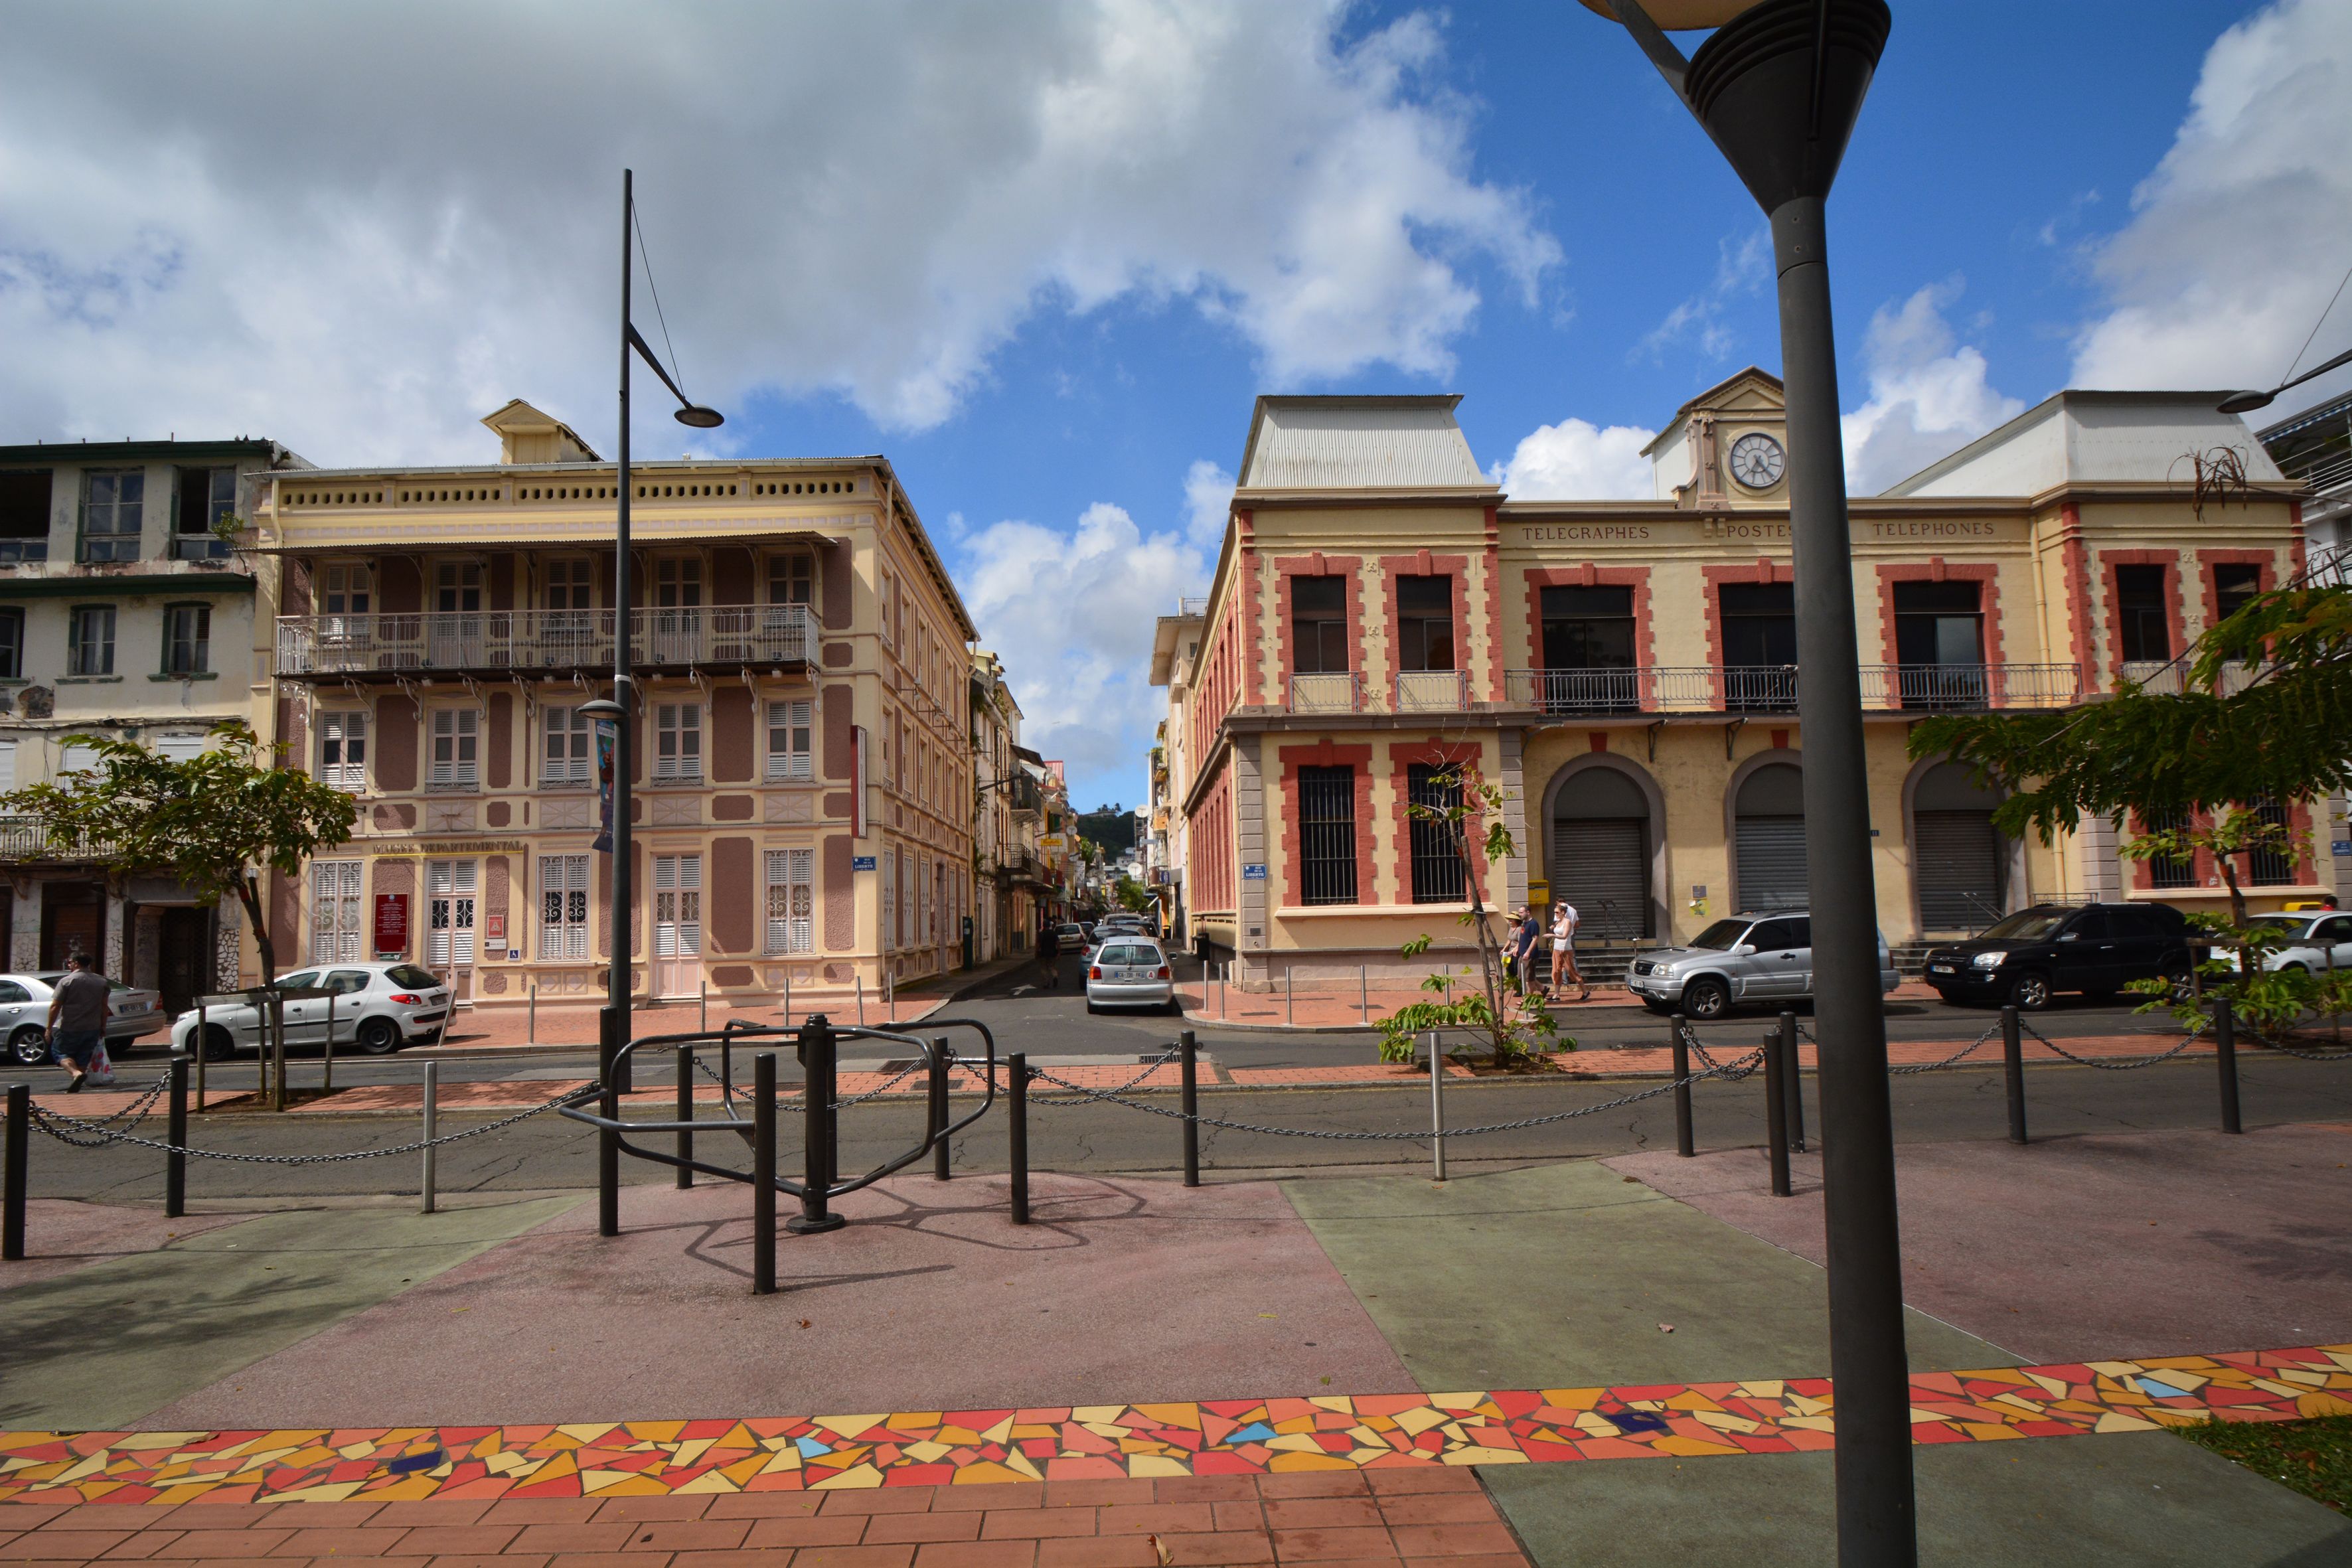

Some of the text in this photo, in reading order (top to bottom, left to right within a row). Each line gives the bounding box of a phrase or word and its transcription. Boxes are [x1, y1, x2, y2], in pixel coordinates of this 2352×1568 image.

[1522, 526, 1650, 540] TELEGRAPHES
[1872, 523, 1994, 536] TELEPHONES
[373, 840, 523, 854] MUSEE DEPARTEMENTAL
